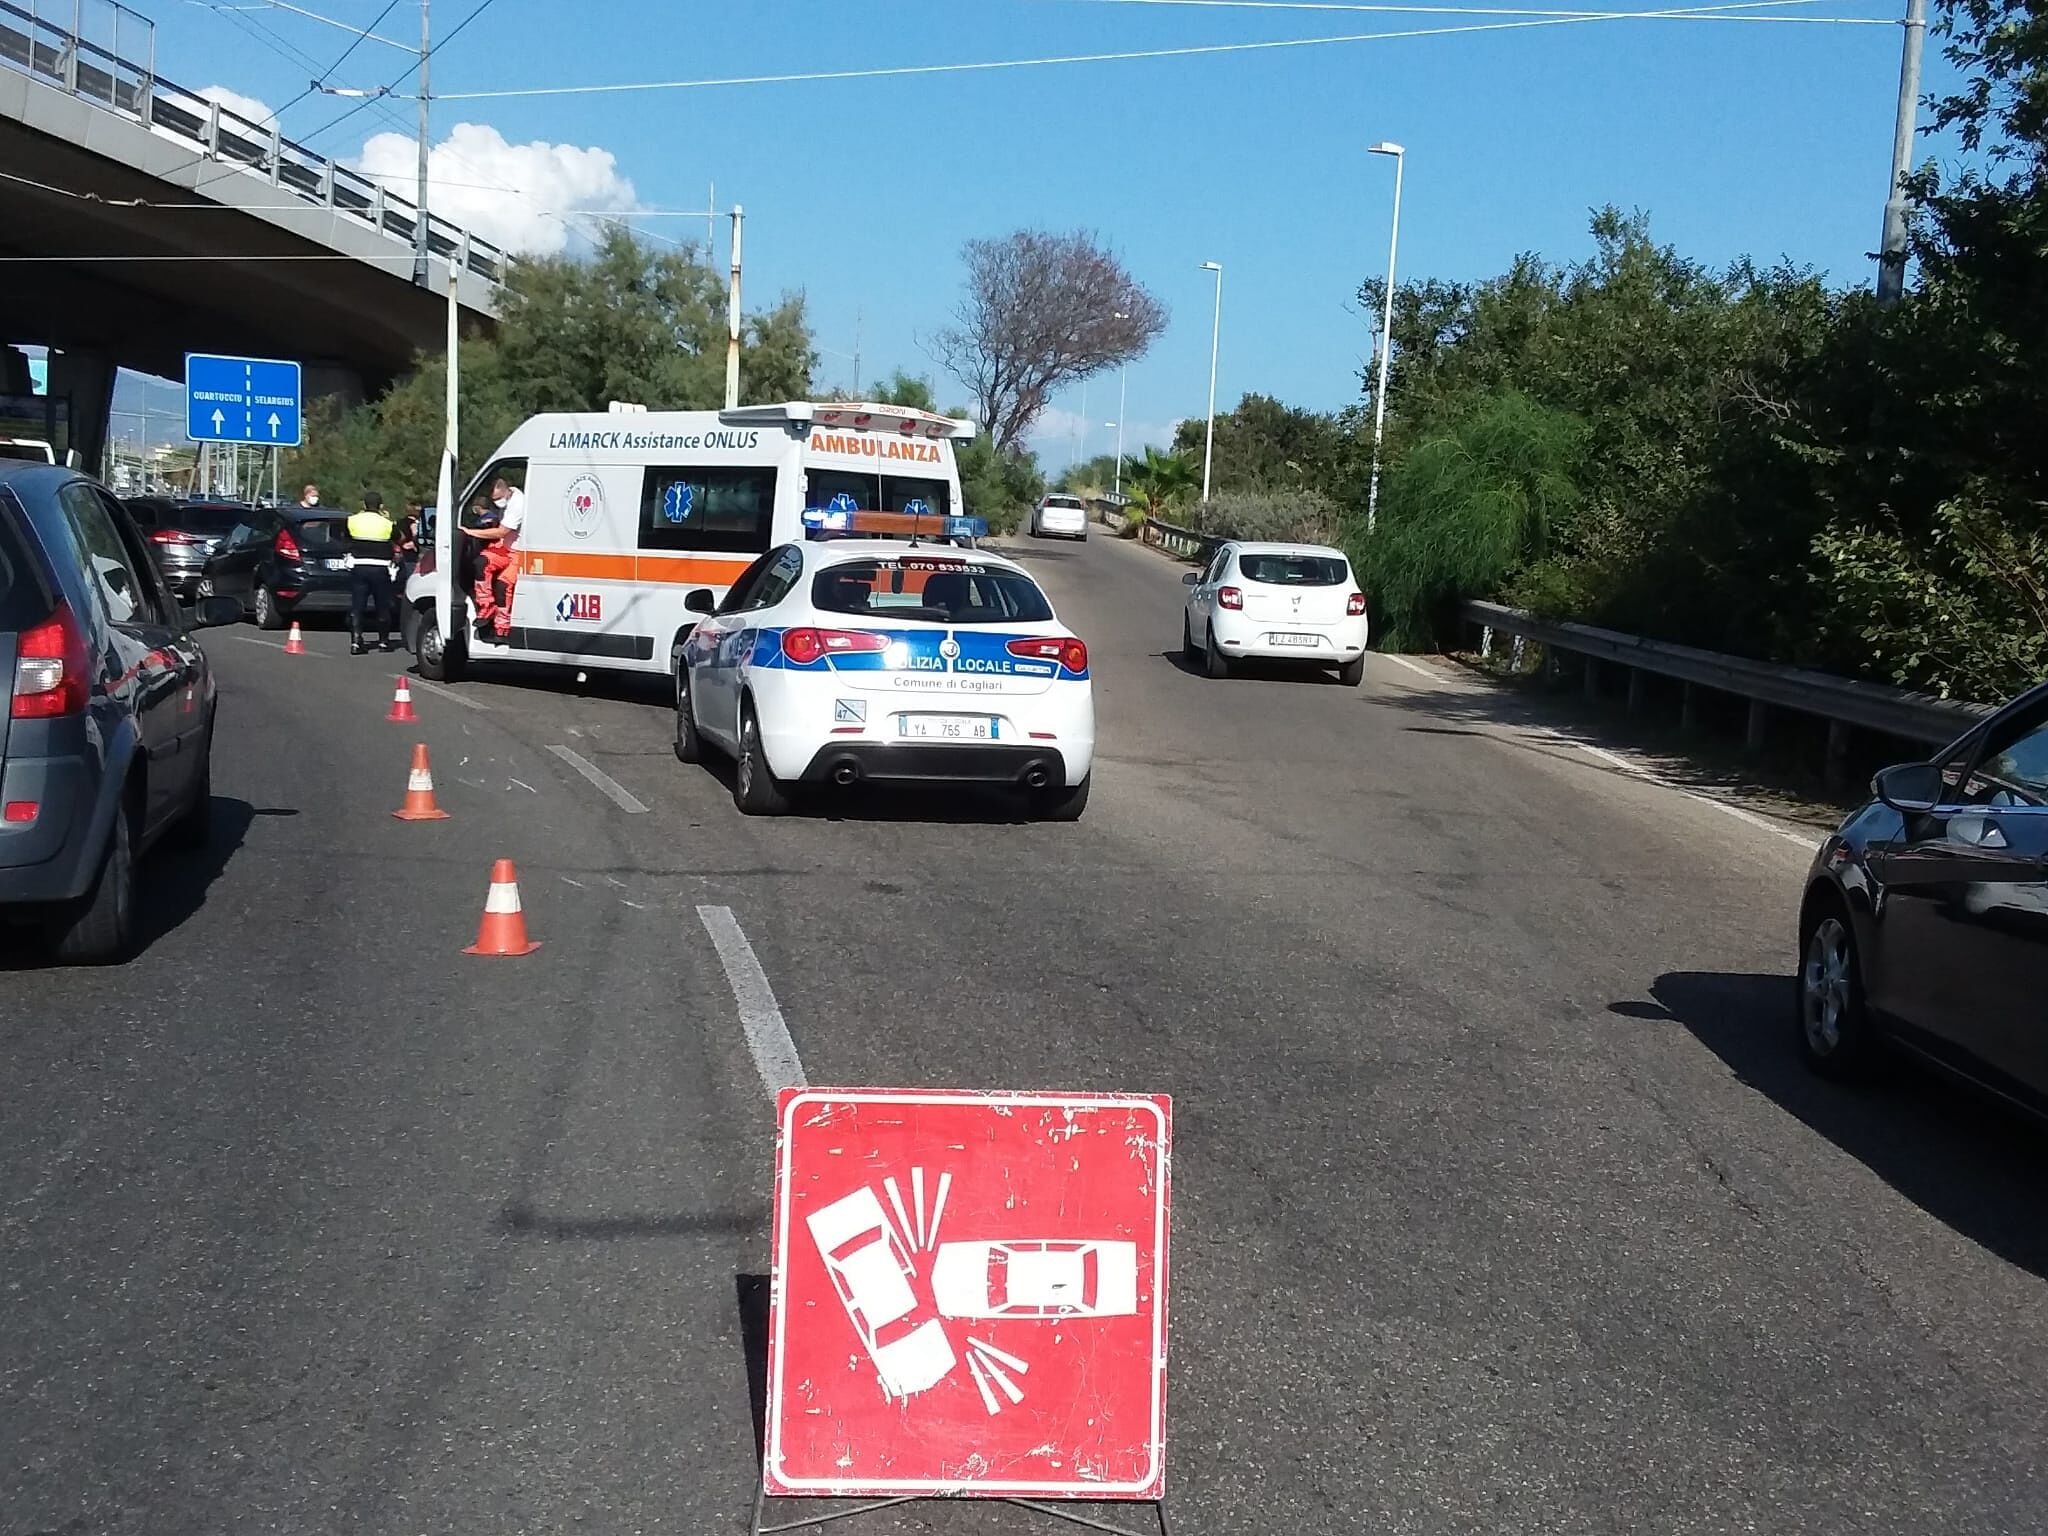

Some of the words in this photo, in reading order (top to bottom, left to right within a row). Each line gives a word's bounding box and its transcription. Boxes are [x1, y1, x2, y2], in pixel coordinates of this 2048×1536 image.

[193, 391, 242, 403] QUARTUCCIU
[254, 394, 295, 406] SELARGIUS
[550, 432, 620, 449] LAMARCK
[622, 432, 700, 449] Assistance
[704, 431, 759, 449] ONLUS
[811, 433, 941, 463] AMBULANZA
[572, 593, 601, 618] 118
[890, 656, 944, 671] OLIZIA
[957, 659, 1011, 673] LOCALE
[894, 677, 942, 688] Comune
[946, 679, 957, 689] di
[960, 680, 1002, 692] Cagliari
[974, 725, 986, 738] AB
